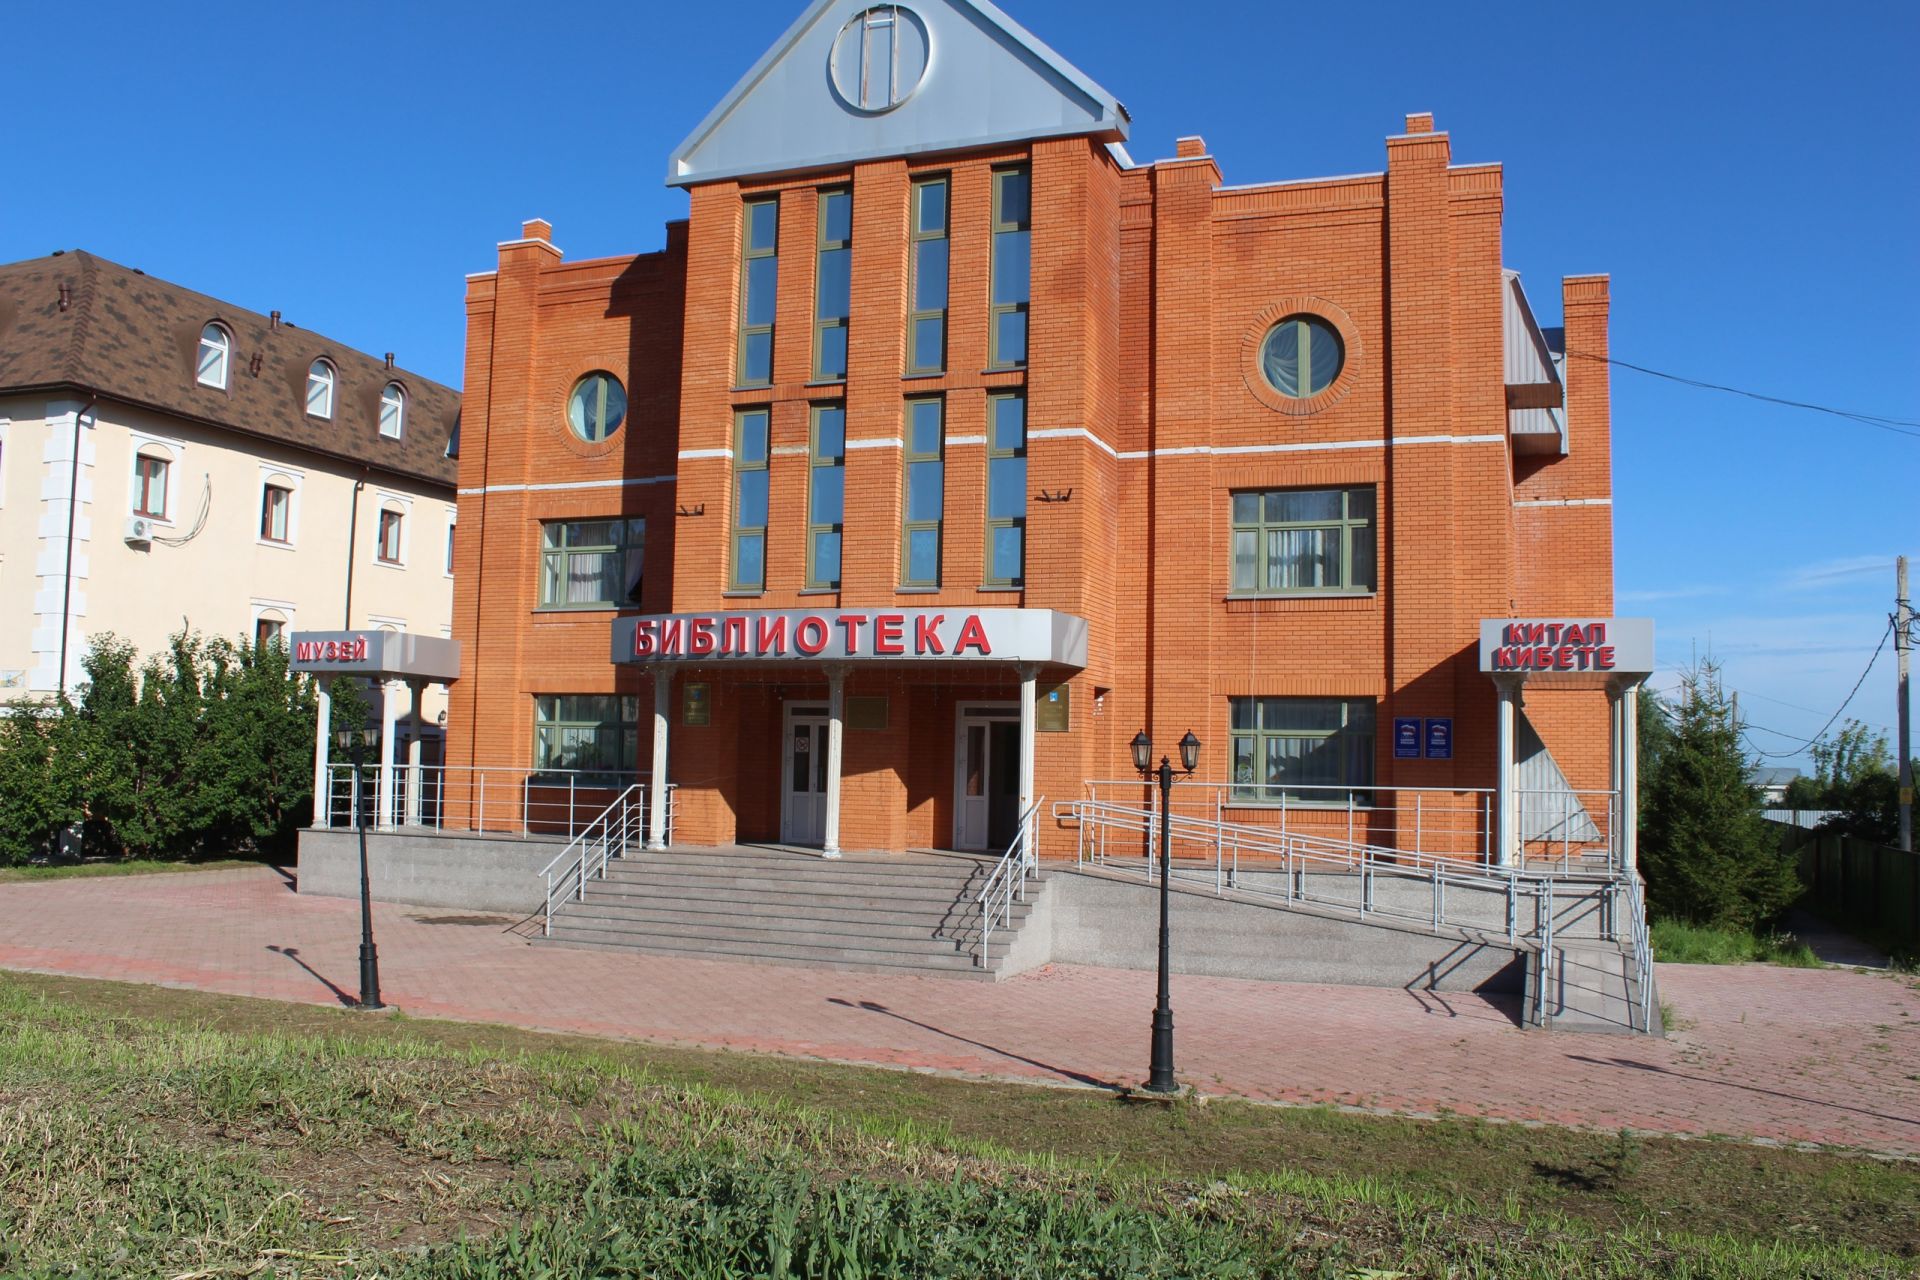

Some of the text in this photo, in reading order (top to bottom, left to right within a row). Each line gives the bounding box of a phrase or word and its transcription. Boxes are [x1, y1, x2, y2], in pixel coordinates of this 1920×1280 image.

[634, 613, 993, 656] БИБЛИОТЕКА
[1507, 622, 1606, 644] КИТАП
[296, 634, 369, 661] МУЗЕЙ
[1497, 646, 1616, 667] КИБЕТЕ
